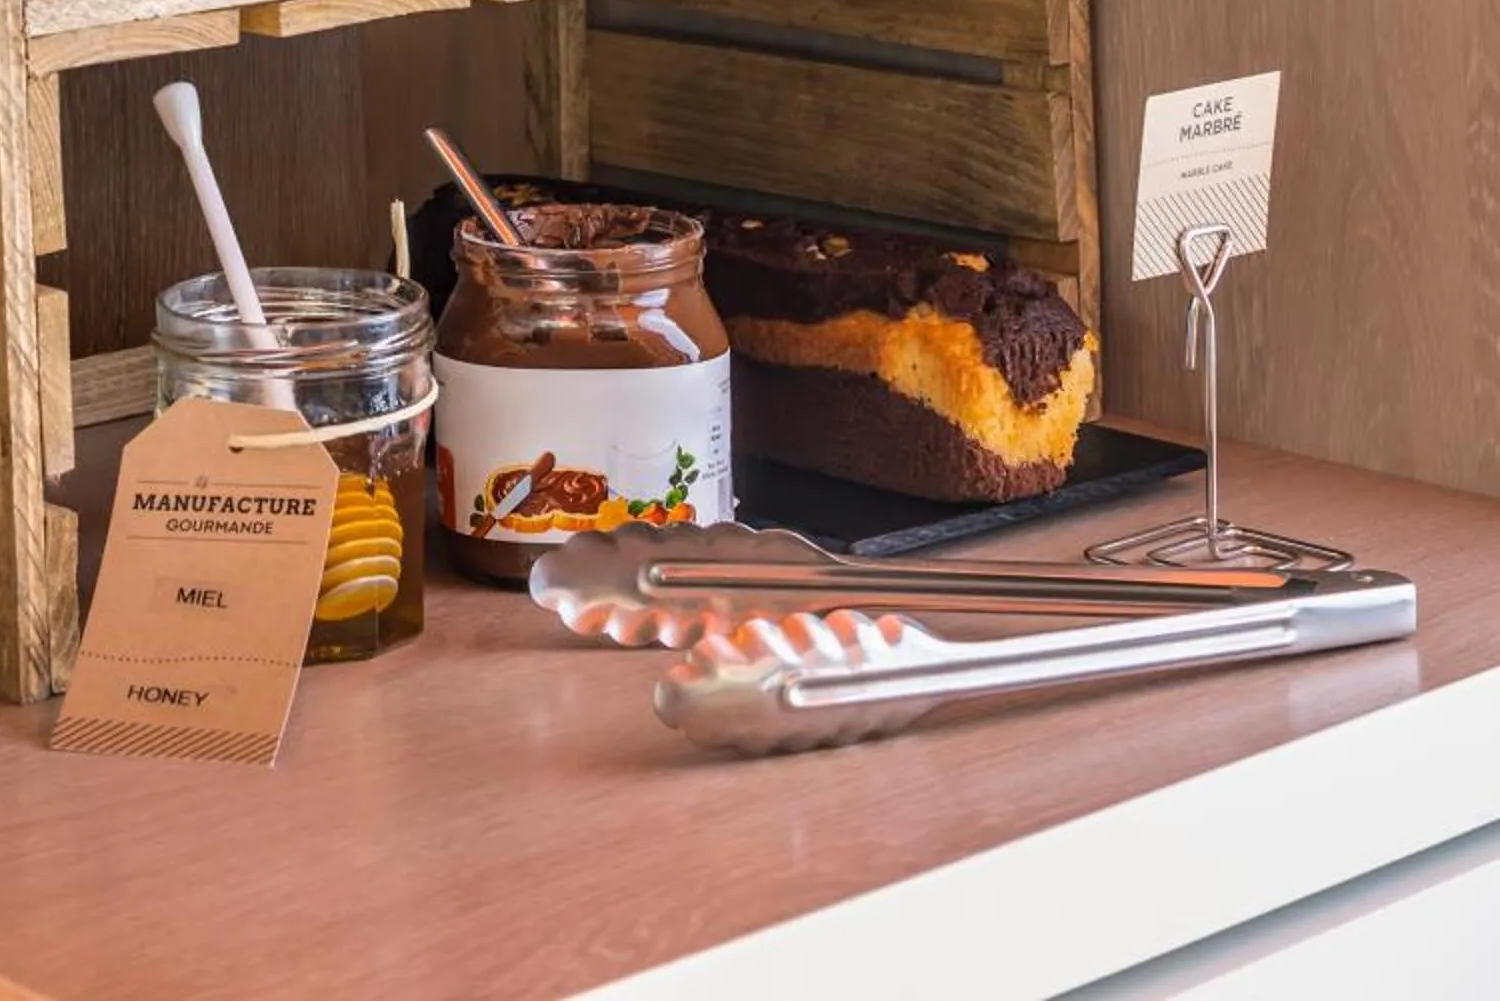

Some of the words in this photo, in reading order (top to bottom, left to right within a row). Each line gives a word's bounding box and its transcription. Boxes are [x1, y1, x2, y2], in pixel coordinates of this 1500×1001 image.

[1193, 96, 1234, 118] CAKE
[132, 493, 317, 517] MANUFACTURE
[165, 518, 274, 536] GOURMANDE
[176, 587, 228, 609] MIEL
[126, 684, 210, 708] HONEY
